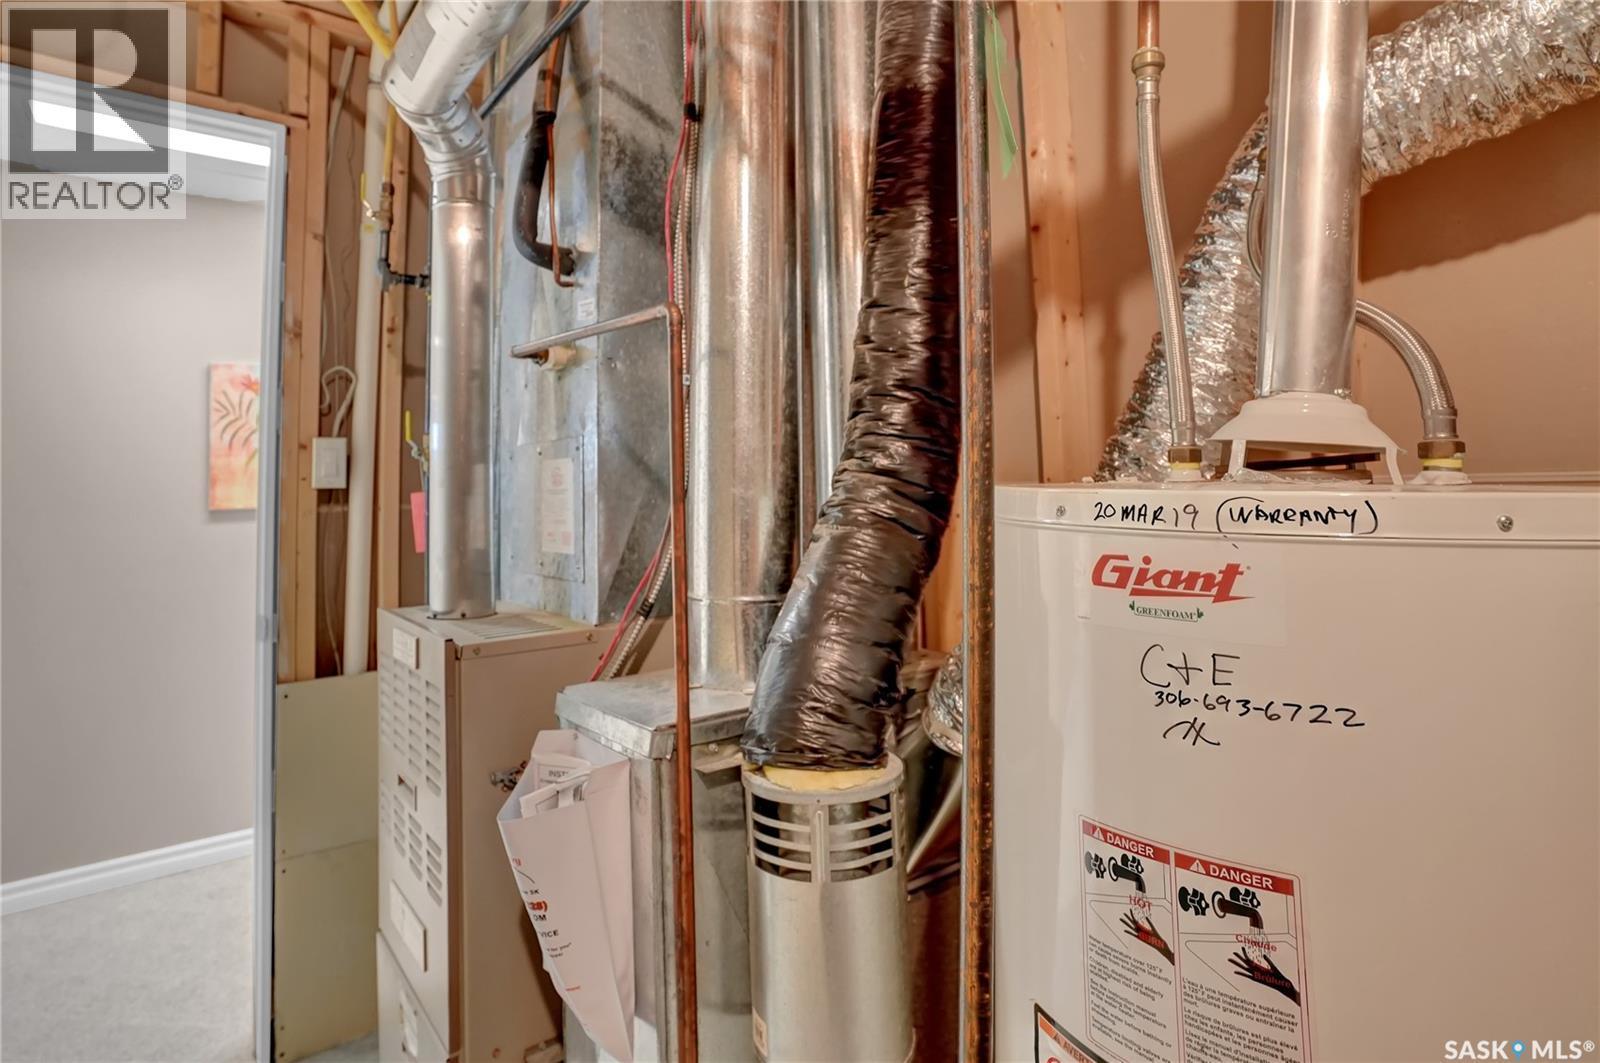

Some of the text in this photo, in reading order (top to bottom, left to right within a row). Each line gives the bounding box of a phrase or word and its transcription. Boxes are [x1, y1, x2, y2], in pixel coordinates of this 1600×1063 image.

[1091, 553, 1246, 604] Giant
[1106, 832, 1154, 858] DANGER
[1209, 864, 1274, 890] DANGER
